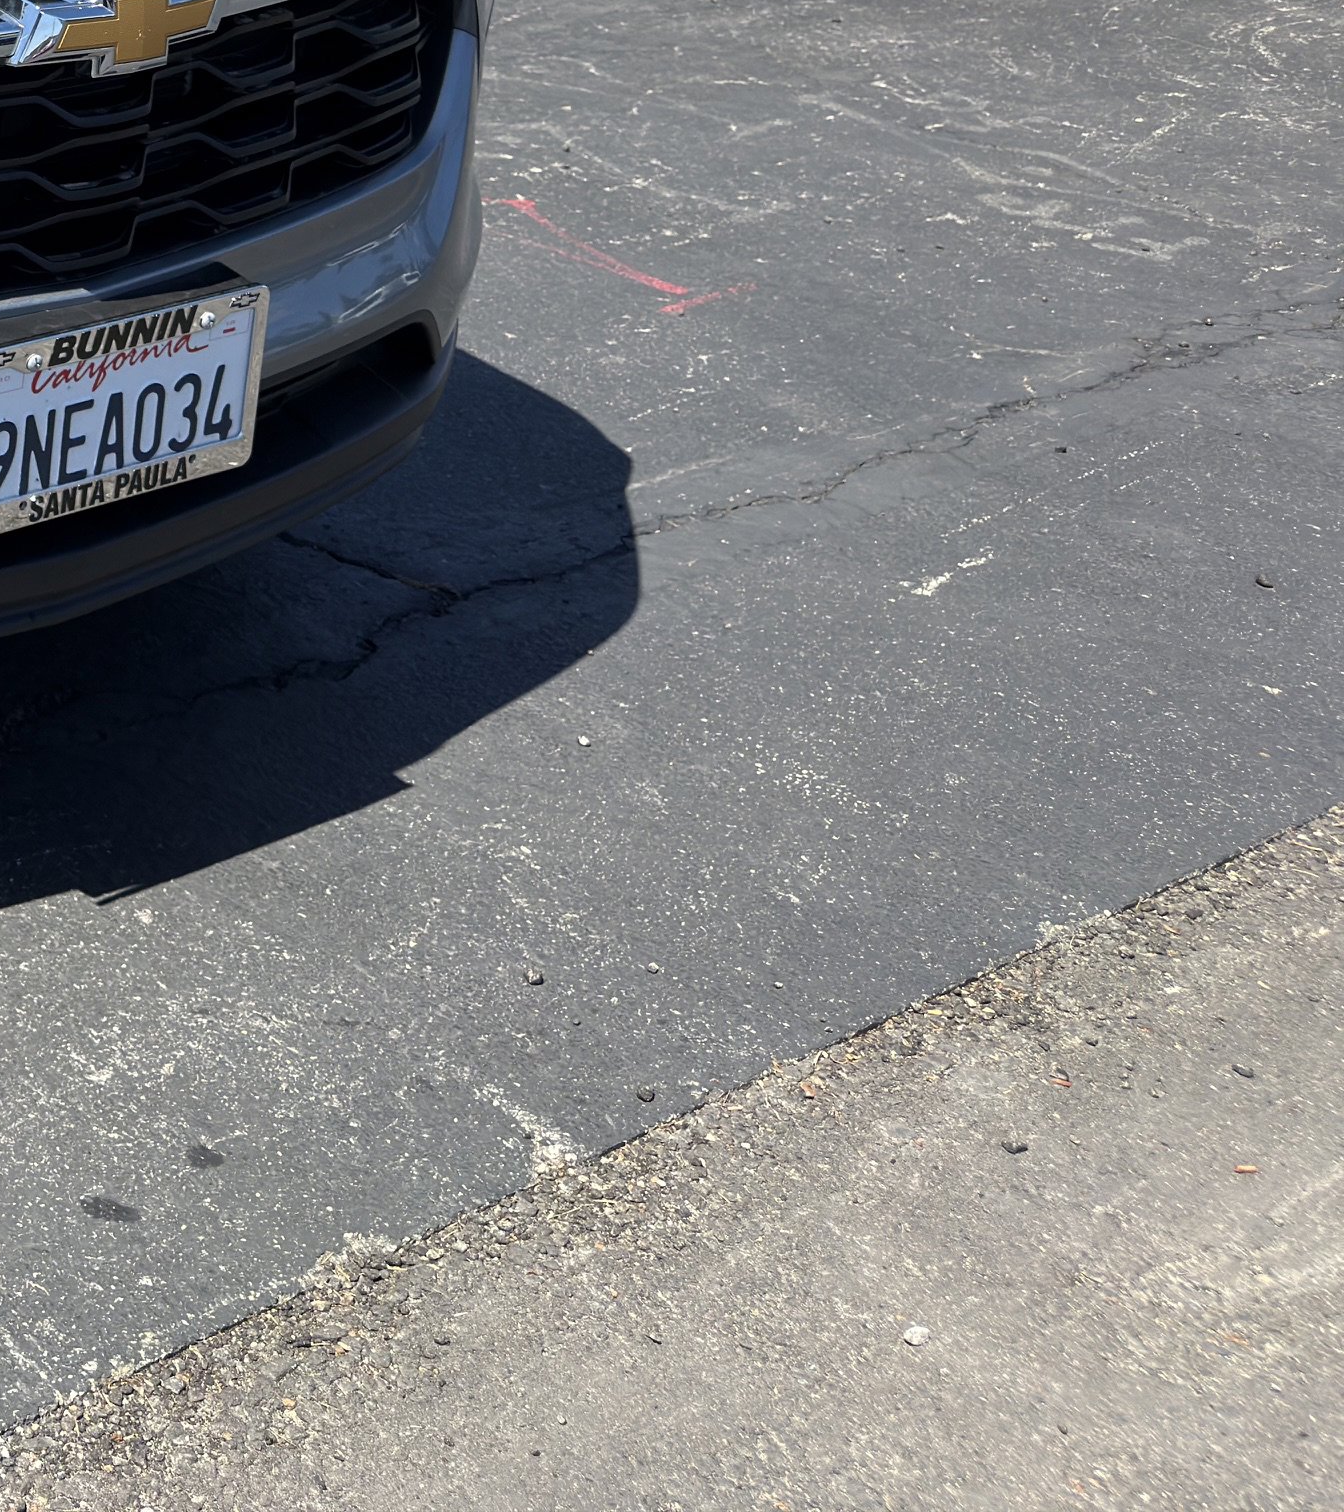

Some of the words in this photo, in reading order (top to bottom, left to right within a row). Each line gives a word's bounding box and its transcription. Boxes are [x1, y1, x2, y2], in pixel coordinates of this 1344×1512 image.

[31, 333, 209, 393] California
[48, 305, 199, 368] BUNNIN
[28, 477, 105, 523] SANTA
[114, 457, 189, 500] PAULA
